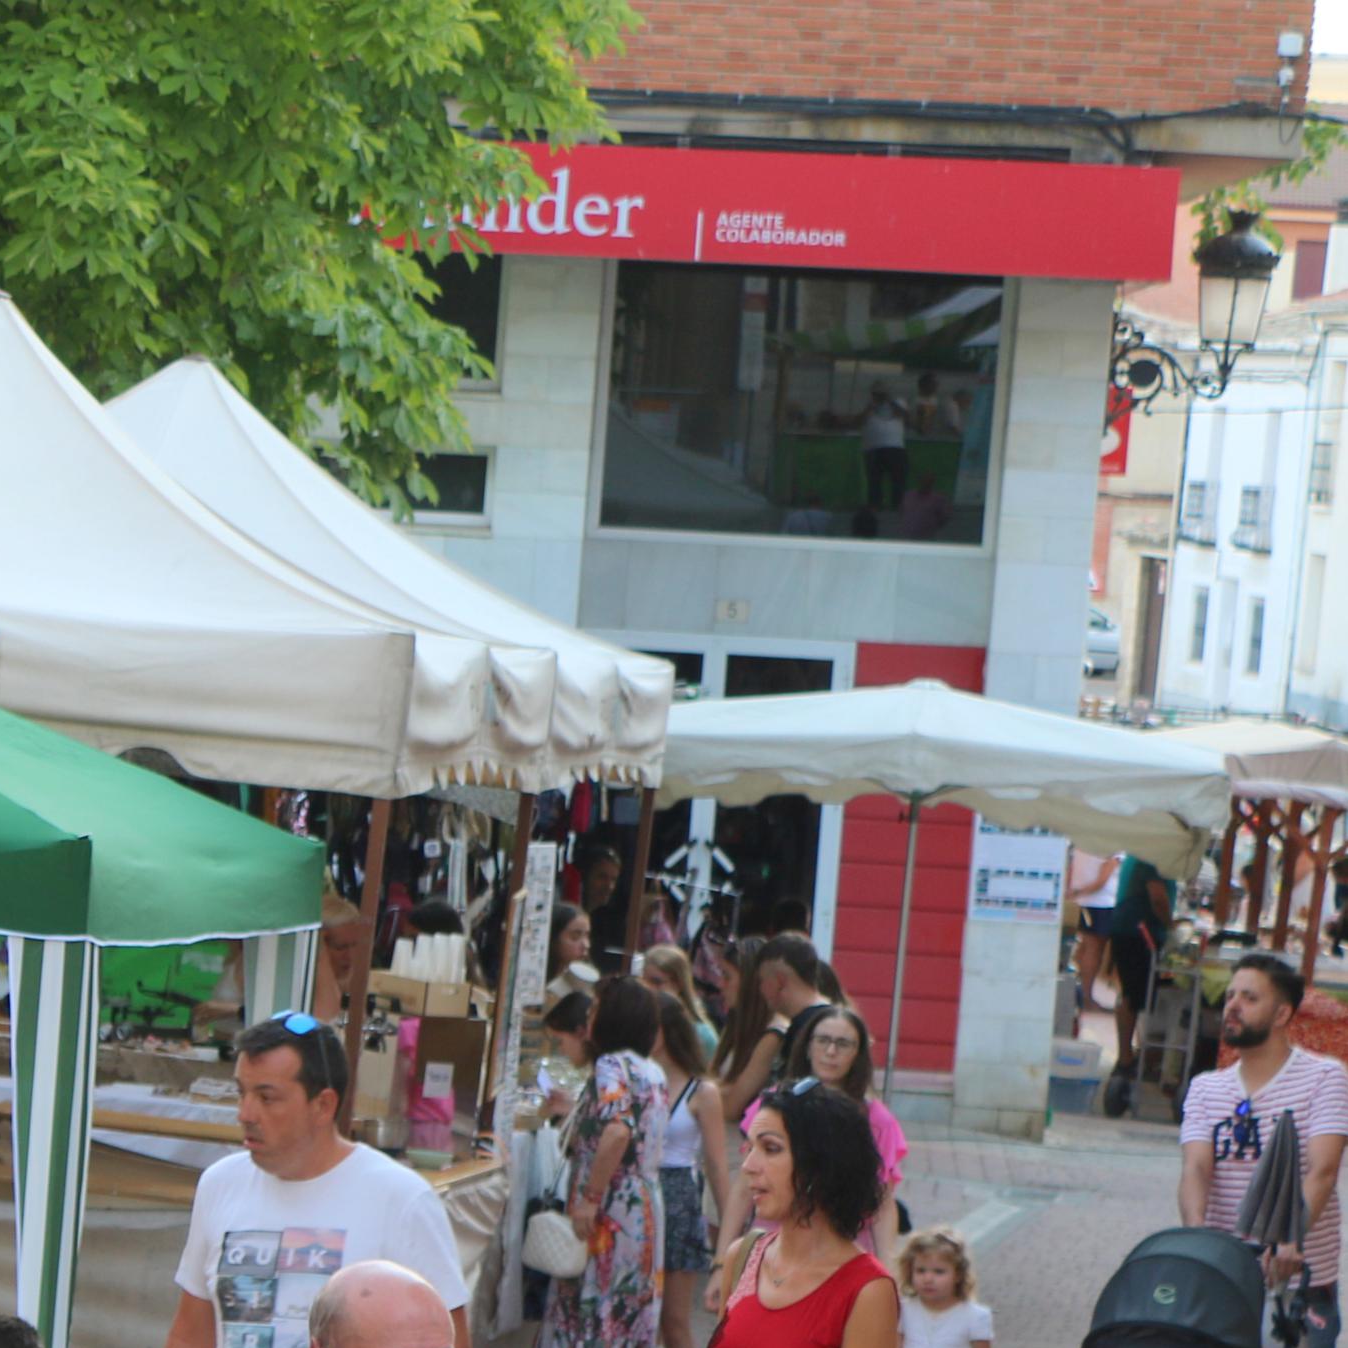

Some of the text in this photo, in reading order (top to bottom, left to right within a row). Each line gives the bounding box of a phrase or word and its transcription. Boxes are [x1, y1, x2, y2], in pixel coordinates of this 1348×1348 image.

[715, 211, 785, 230] AGENTE
[715, 228, 847, 247] COLABORADOR
[226, 1246, 327, 1269] QUIK
